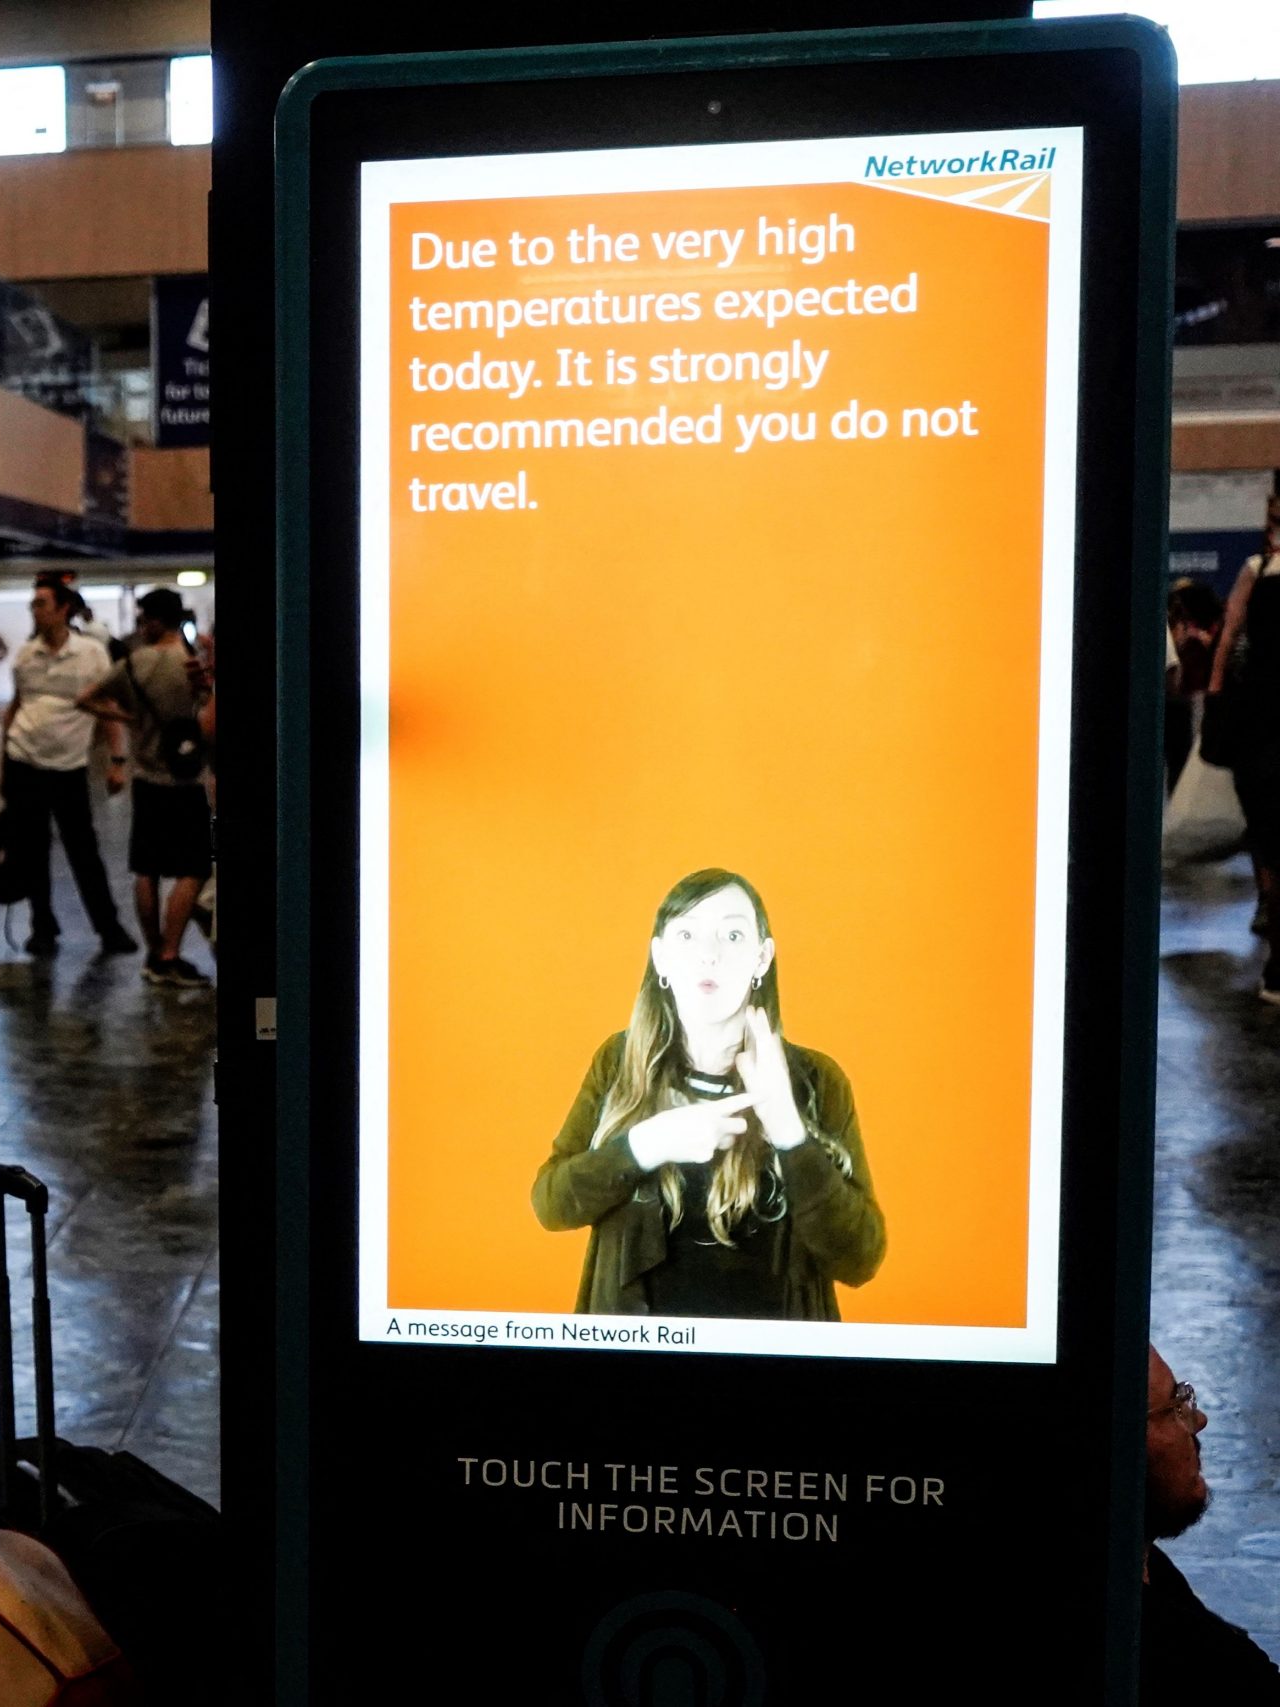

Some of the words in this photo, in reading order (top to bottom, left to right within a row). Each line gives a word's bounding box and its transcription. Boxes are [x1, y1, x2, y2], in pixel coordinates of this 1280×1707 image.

[411, 232, 497, 271] Due
[508, 231, 555, 268] to
[566, 223, 640, 266] the
[651, 224, 745, 268] very
[756, 212, 856, 264] high
[409, 286, 703, 338] temperatures
[714, 273, 919, 328] expected
[409, 350, 542, 399] today.
[556, 347, 593, 388] It
[605, 348, 638, 388] is
[648, 338, 829, 390] strongly
[410, 402, 723, 453] recommended
[734, 411, 817, 453] you
[830, 400, 889, 440] do
[901, 400, 979, 438] not
[409, 469, 538, 513] travel.
[386, 1317, 402, 1336] A
[407, 1323, 499, 1344] message
[505, 1320, 555, 1341] from
[562, 1323, 650, 1344] Network
[657, 1325, 696, 1346] Rail
[458, 1457, 589, 1490] TOUCH
[605, 1463, 679, 1494] THE
[695, 1467, 847, 1502] SCREEN
[866, 1474, 945, 1506] FOR
[558, 1501, 839, 1542] INFORMATION
